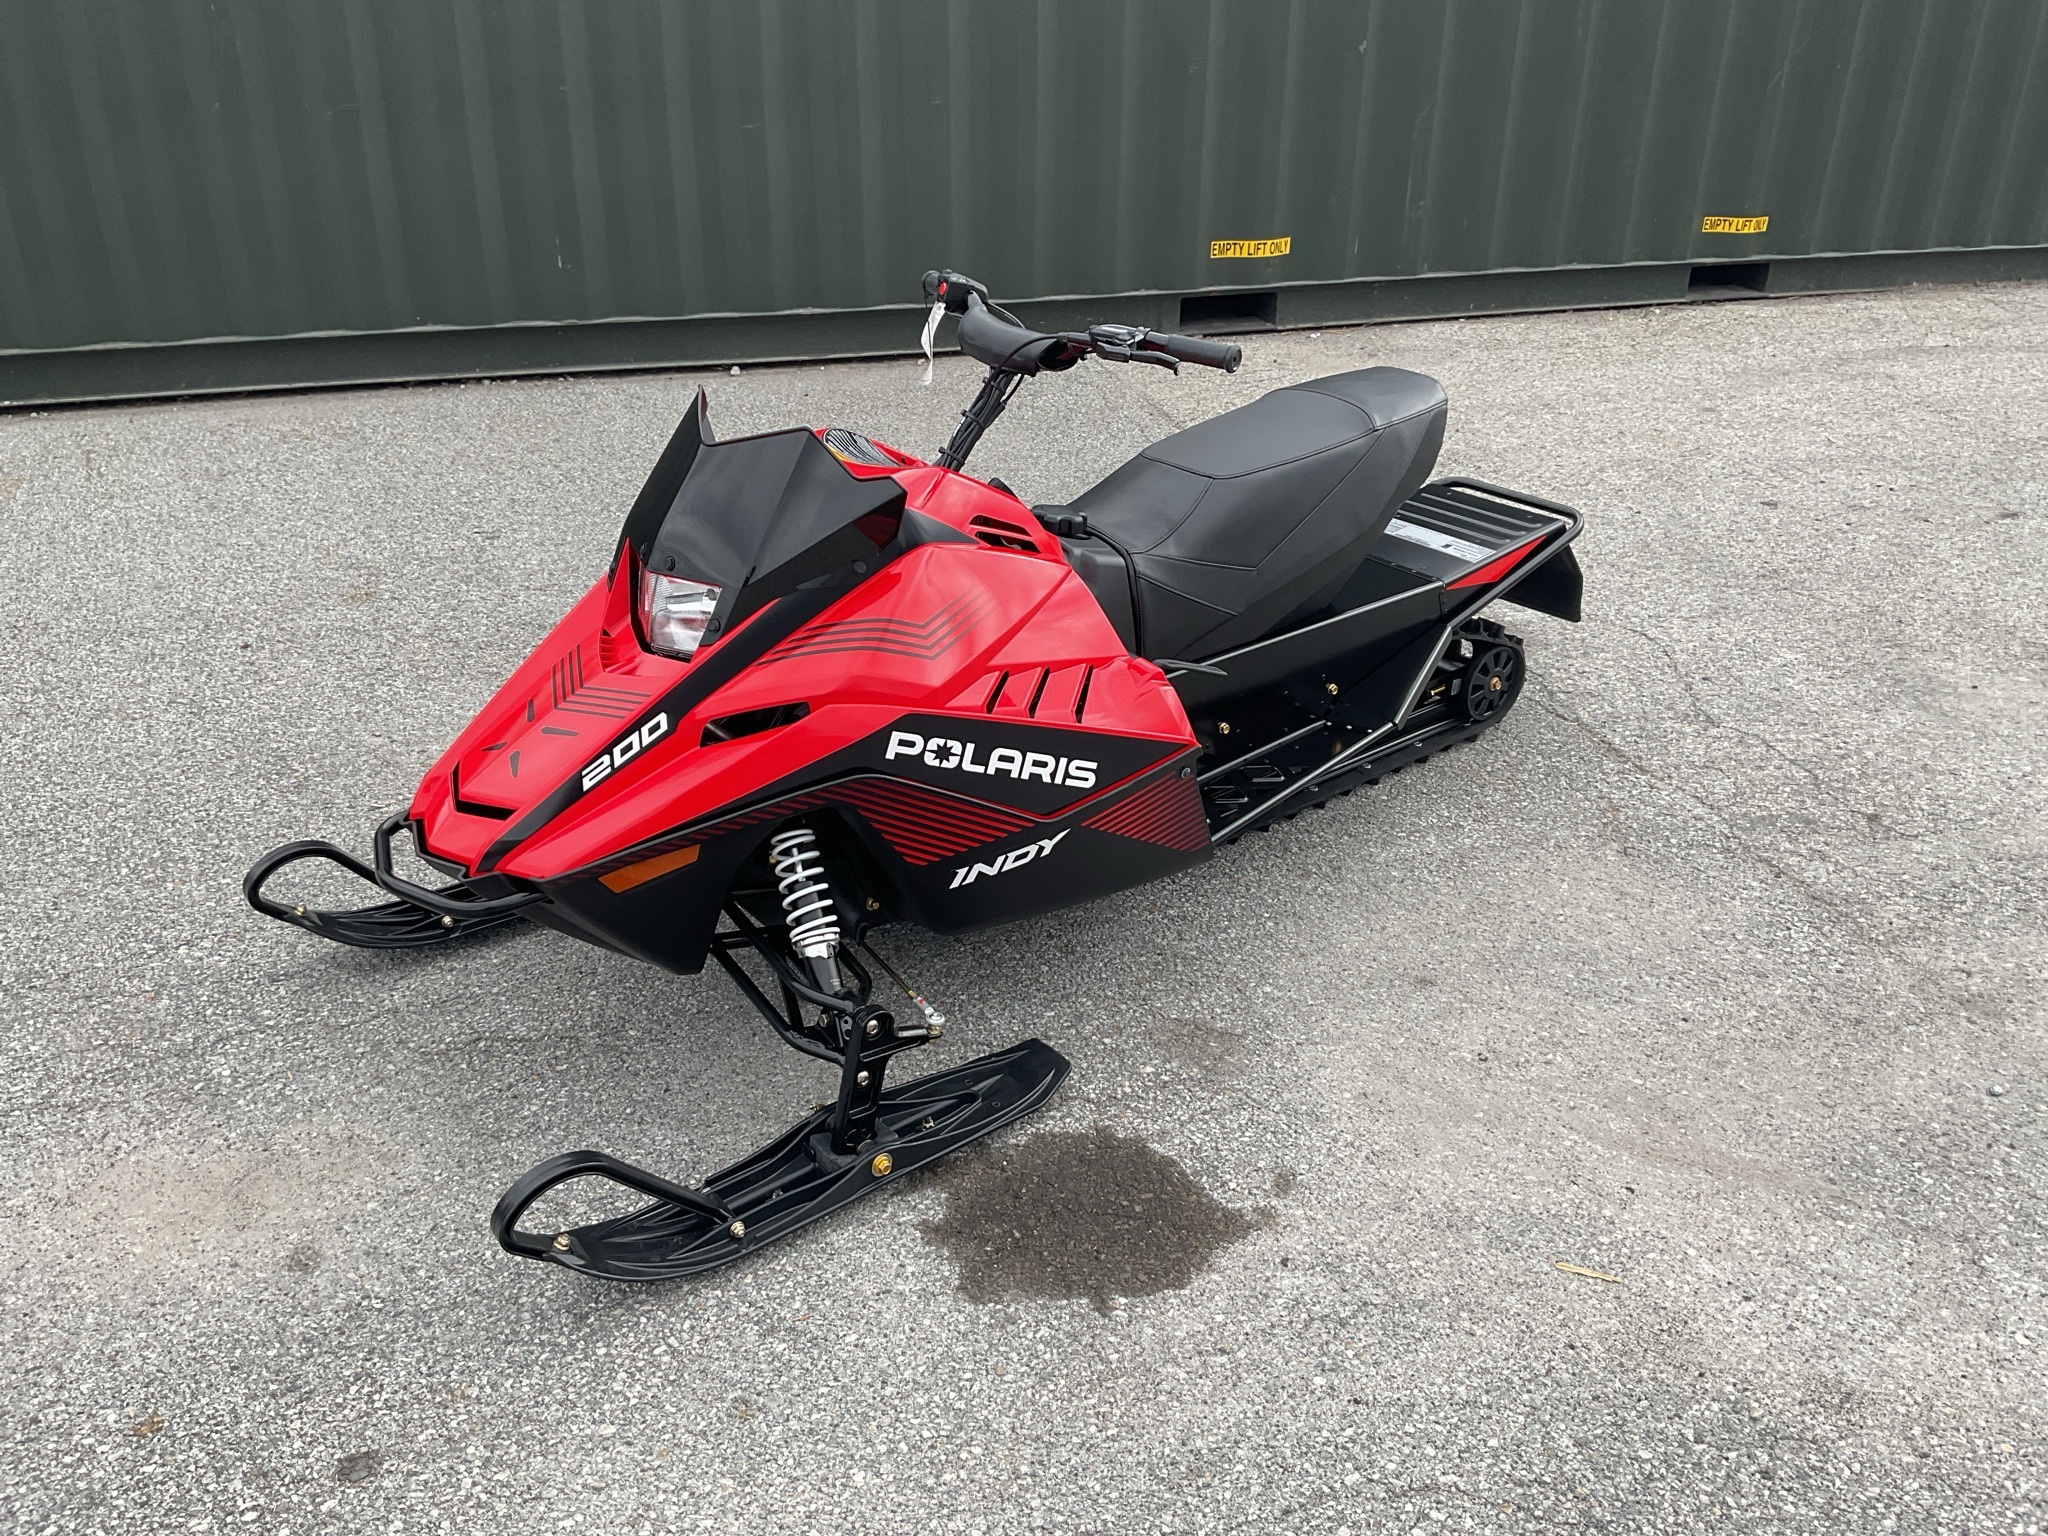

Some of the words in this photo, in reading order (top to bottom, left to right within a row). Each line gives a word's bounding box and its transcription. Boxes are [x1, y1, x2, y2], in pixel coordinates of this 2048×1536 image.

[1212, 242, 1245, 256] EMPTY
[1247, 242, 1268, 256] LIFT
[1269, 239, 1289, 255] ONLY
[1703, 218, 1734, 231] EMPTY
[1735, 219, 1753, 232] LIFT
[581, 711, 669, 792] 200
[885, 730, 1098, 789] POLARIS
[949, 828, 1071, 890] INDY
